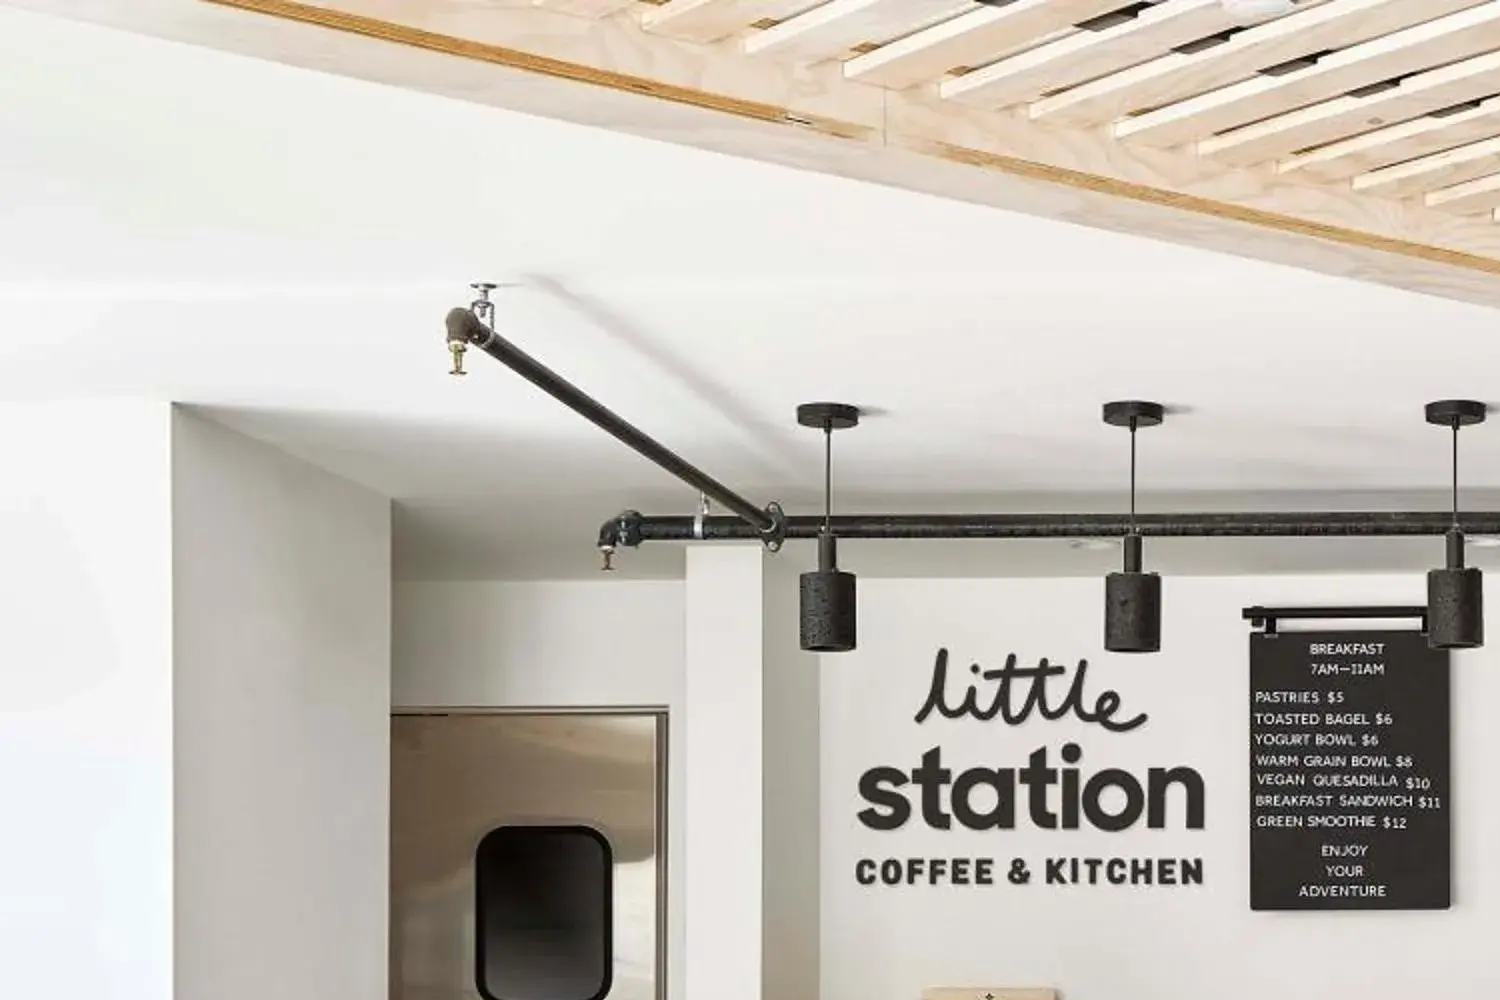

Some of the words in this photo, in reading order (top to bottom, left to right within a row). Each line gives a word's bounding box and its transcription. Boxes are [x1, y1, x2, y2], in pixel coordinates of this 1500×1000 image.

[1310, 643, 1384, 654] BREAKFAST
[914, 647, 1148, 732] little
[1256, 692, 1319, 703] PASTRIES
[1328, 691, 1344, 704] $5
[1255, 713, 1320, 724] TOASTED
[1326, 714, 1370, 724] BAGEL
[1376, 713, 1392, 724] $6
[1255, 734, 1310, 745] YOGURT
[1316, 734, 1356, 746] BOWL
[1362, 734, 1378, 746] $6
[1256, 755, 1298, 766] WARM
[1304, 756, 1346, 766] GRAIN
[1352, 756, 1391, 767] BOWL
[857, 743, 1204, 832] station
[1257, 774, 1304, 785] VEGAN
[1313, 775, 1398, 786] QUESADILLA
[1406, 778, 1430, 789] $10
[1256, 795, 1333, 806] BREAKFAST
[1340, 795, 1412, 806] SANDWICH
[1419, 796, 1440, 808] $11
[1257, 816, 1302, 827] GREEN
[1308, 816, 1376, 826] SMOOTHIE
[1383, 816, 1406, 828] $12
[1322, 845, 1368, 856] ENJOY
[856, 859, 993, 885] COFFEE
[1008, 858, 1030, 884] &
[1046, 858, 1202, 885] KITCHEN
[1326, 866, 1363, 877] YOUR
[1299, 885, 1386, 896] ADVENTURE
